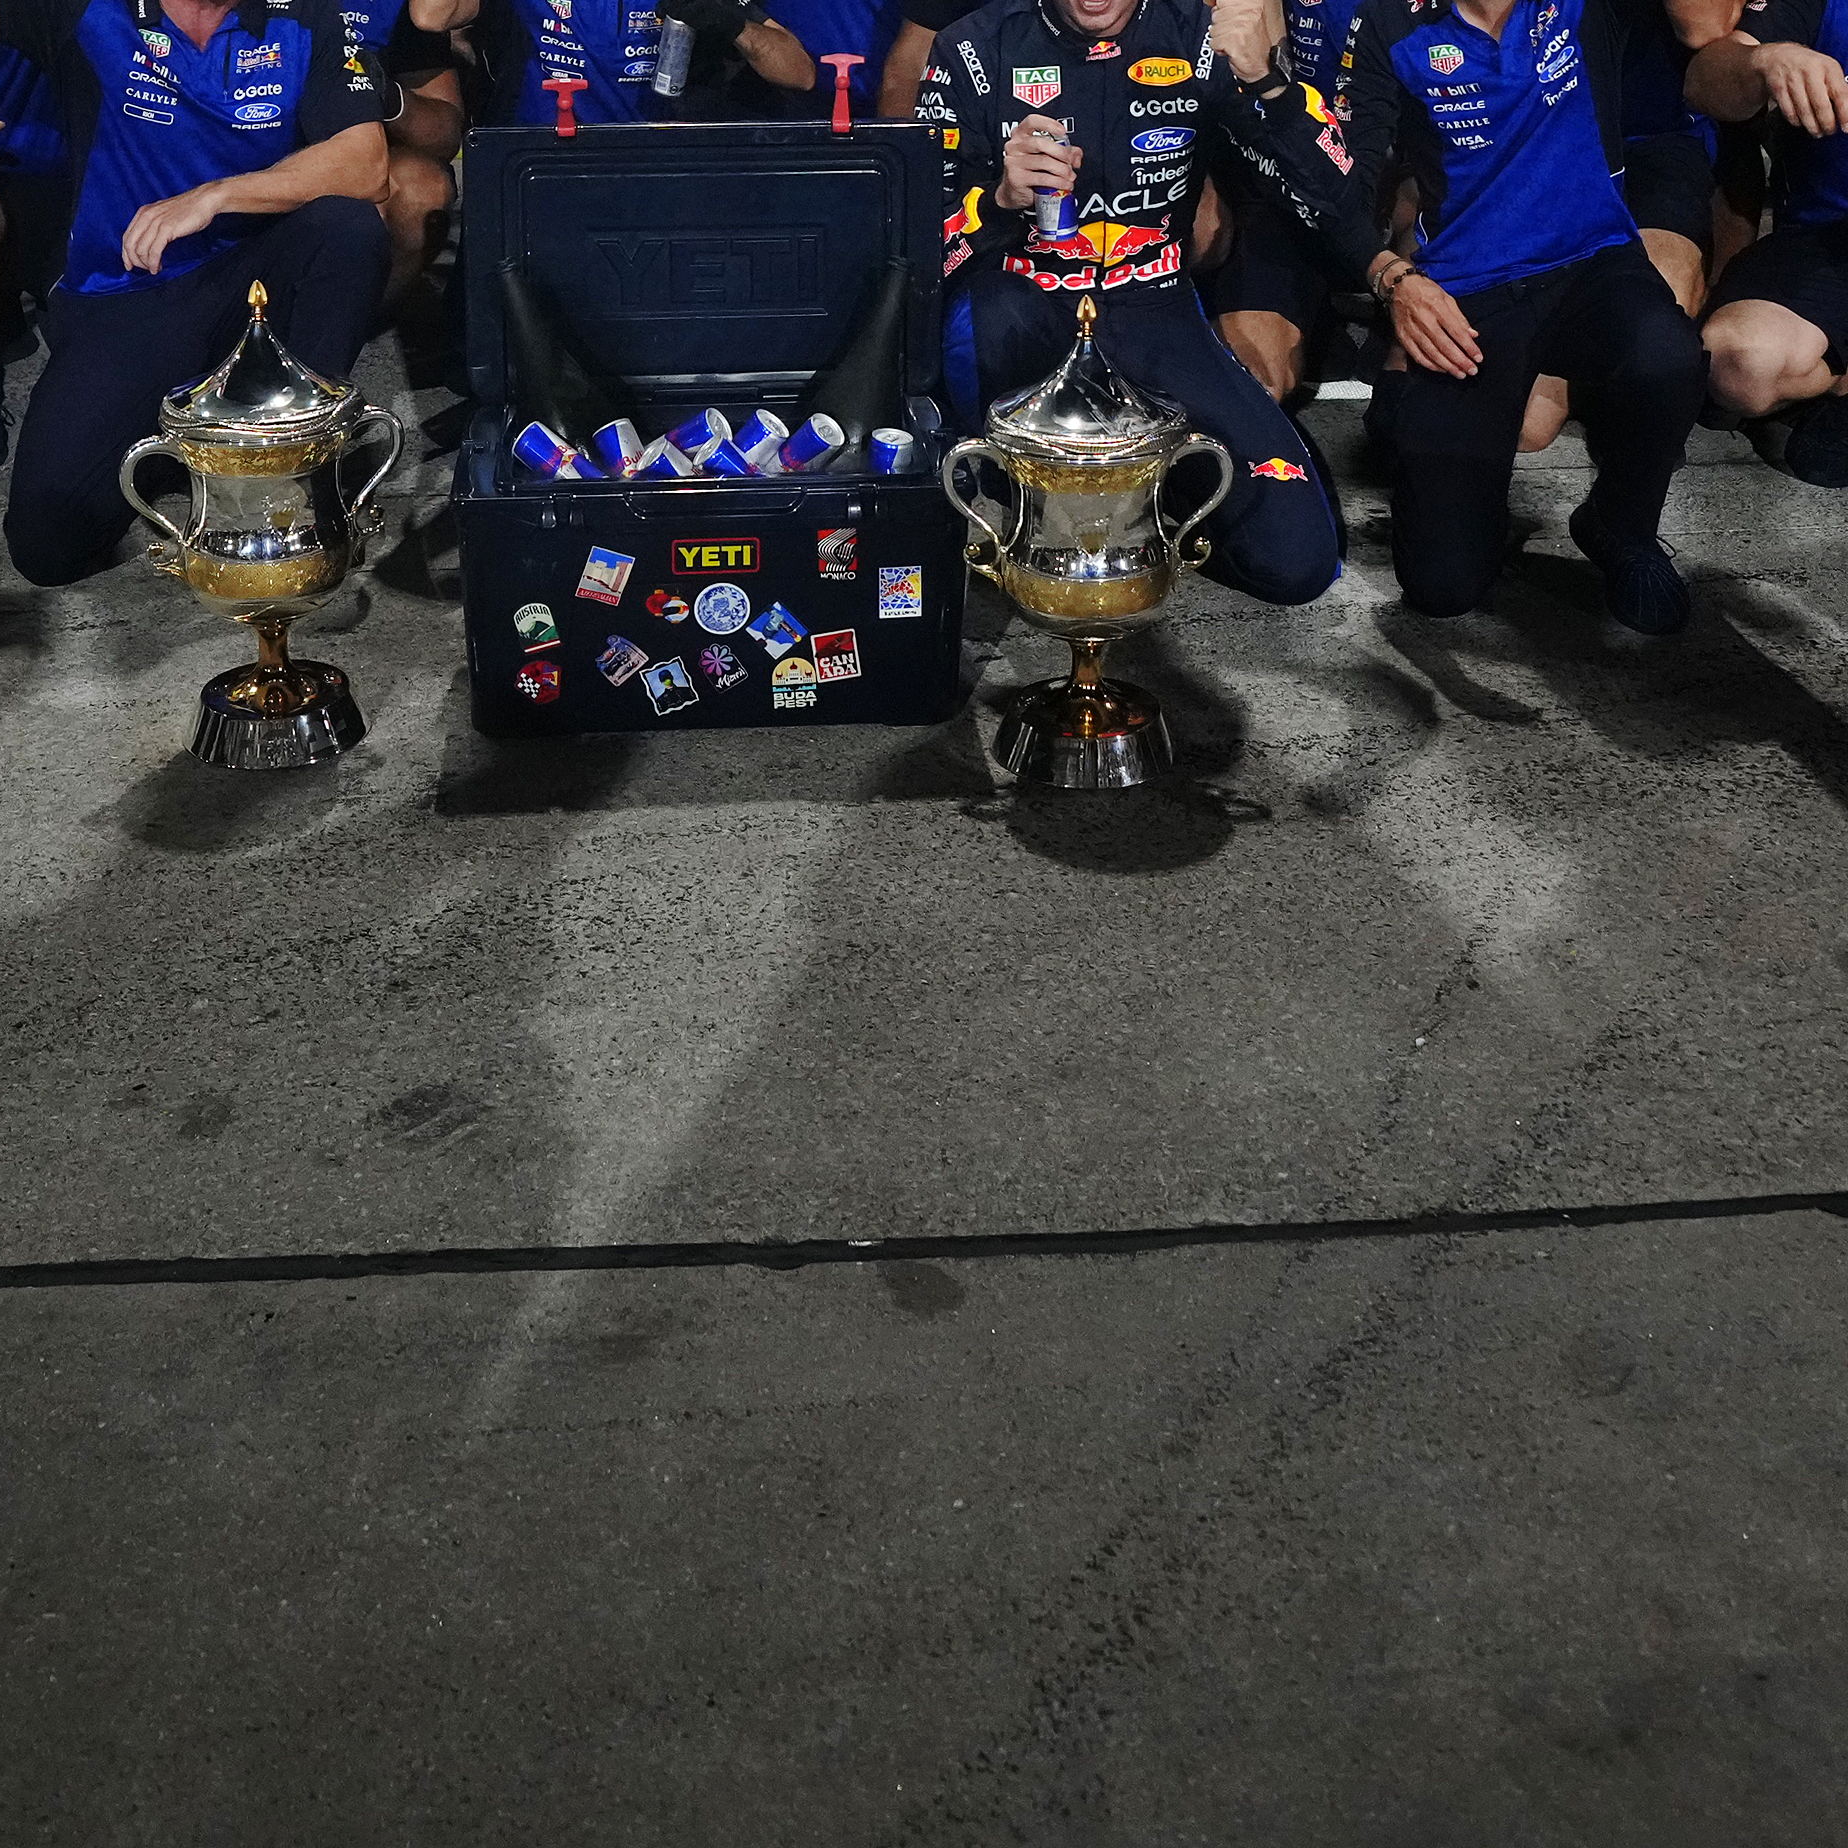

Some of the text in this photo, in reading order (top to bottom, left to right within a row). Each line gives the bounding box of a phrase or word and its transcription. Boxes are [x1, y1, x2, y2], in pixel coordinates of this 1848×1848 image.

[539, 51, 586, 68] CARLYLE
[1430, 45, 1461, 58] TAG
[957, 39, 991, 96] sparco
[1144, 64, 1186, 78] RAUCH
[1430, 56, 1463, 75] HEUER
[1016, 69, 1057, 83] TAG
[125, 87, 179, 107] CARLYLE
[245, 82, 283, 98] Gate
[1015, 84, 1059, 107] HEUER
[1426, 82, 1467, 98] Mobil
[1146, 96, 1199, 115] Gate
[1433, 100, 1486, 113] ORACLE
[231, 120, 282, 130] RACING
[1437, 117, 1491, 130] CARLYLE
[1144, 130, 1185, 151] Ford
[1451, 134, 1486, 147] VISA
[1315, 127, 1355, 176] Red Bull
[595, 235, 819, 307] YETI
[1101, 239, 1182, 290] Bull
[677, 544, 752, 568] YETI
[819, 570, 857, 581] MONACO
[514, 606, 551, 626] AUSTRIA
[820, 653, 855, 669] CAN
[820, 664, 858, 680] ADA
[772, 690, 818, 702] BUDA
[773, 698, 817, 710] PEST
